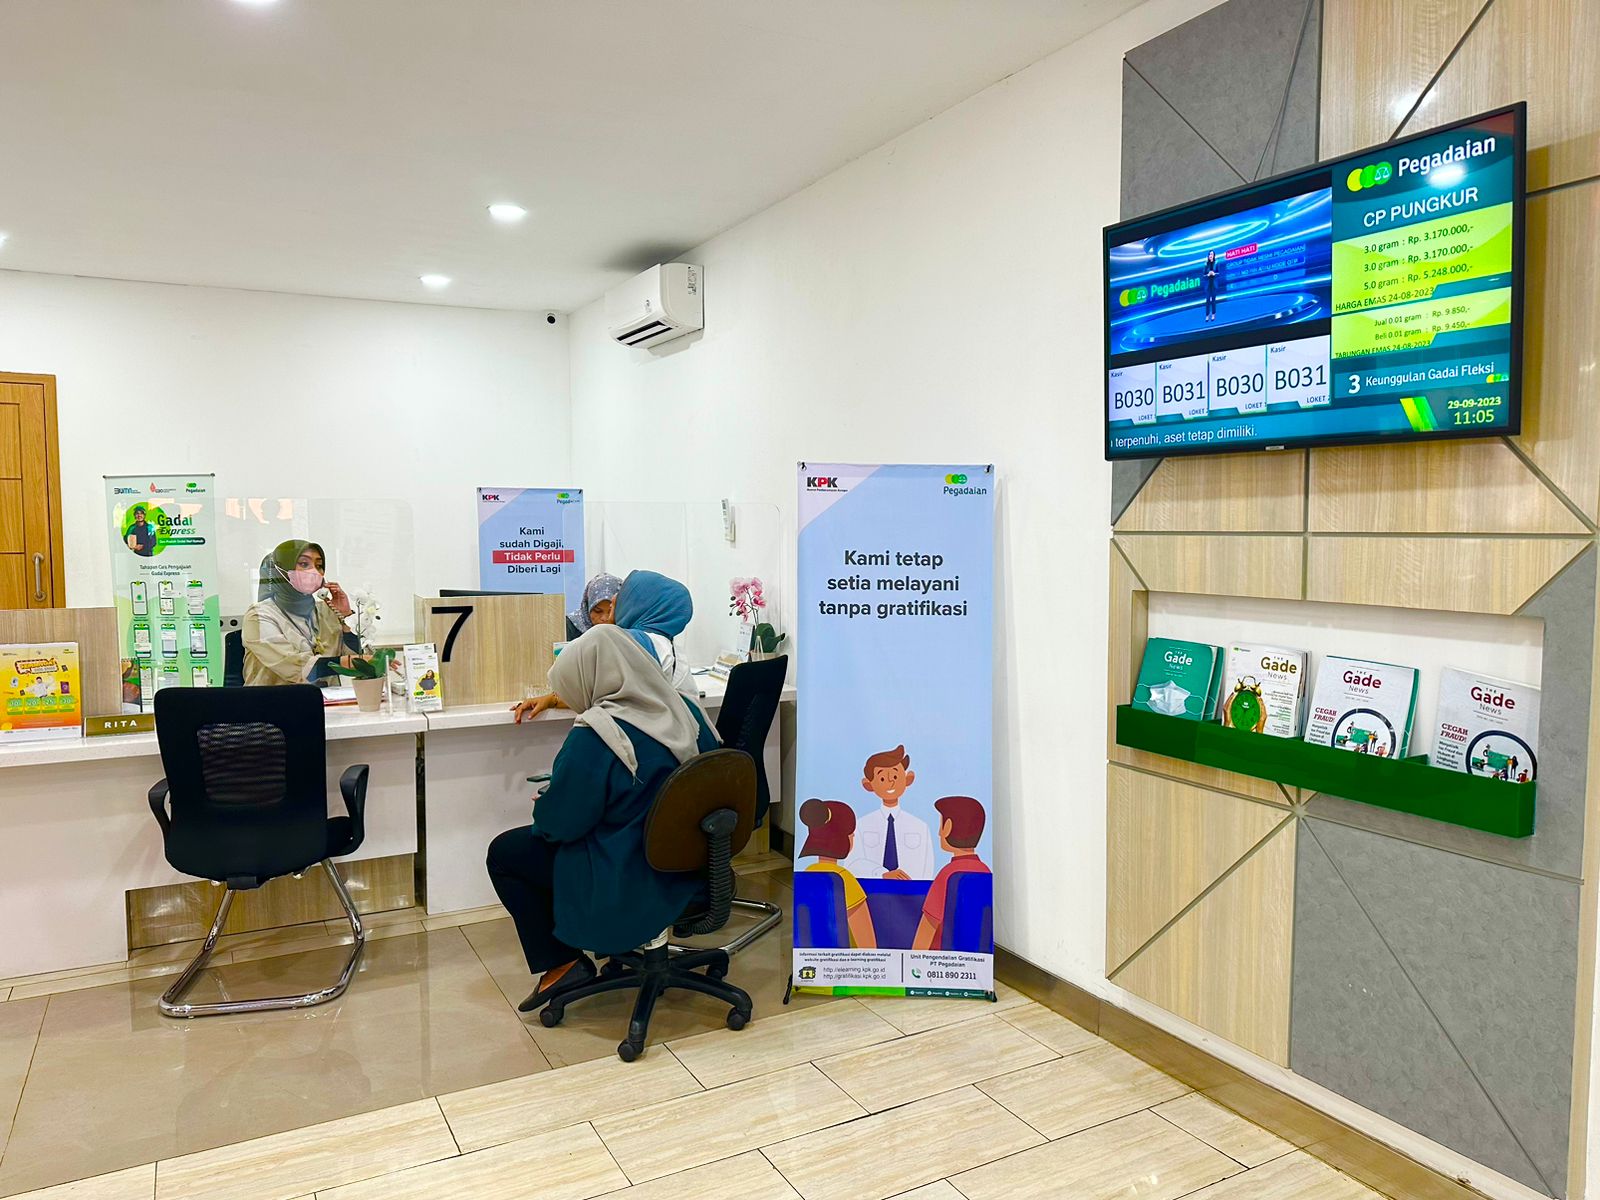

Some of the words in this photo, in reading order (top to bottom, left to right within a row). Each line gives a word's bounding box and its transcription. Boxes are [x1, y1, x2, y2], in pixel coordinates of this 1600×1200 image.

[1398, 137, 1496, 176] Pegadaian
[1363, 209, 1387, 228] CP
[1390, 186, 1479, 222] PUNGKUR
[1364, 243, 1377, 254] 3.0
[1378, 239, 1399, 253] gram
[1407, 233, 1422, 246] Rp.
[1423, 223, 1474, 241] 3.170.000,-
[1364, 263, 1377, 273] 3.0
[1378, 258, 1399, 272] gram
[1407, 253, 1422, 265] Rp.
[1423, 243, 1474, 261] 3.170.000,-
[1364, 281, 1377, 291] 5.0
[1378, 277, 1399, 290] gram
[1407, 272, 1422, 283] Rp.
[1423, 263, 1473, 279] 5.248.000,-
[1151, 276, 1201, 298] Pegadaian
[1335, 301, 1362, 311] HARGA
[1364, 296, 1387, 307] EMAS
[1388, 287, 1434, 302] 24-08-2023
[1374, 318, 1388, 327] Jual
[1388, 315, 1403, 324] 0.01
[1403, 313, 1422, 325] gram
[1375, 331, 1387, 341] Beli
[1388, 329, 1403, 339] 0.01
[1403, 327, 1422, 338] gram
[1270, 345, 1286, 353] Kasir
[1212, 354, 1227, 362] Kasir
[1275, 365, 1327, 390] B031
[1366, 370, 1426, 387] Keunggulan
[1428, 365, 1459, 380] Gadai
[1461, 361, 1495, 376] Fleksi
[1163, 380, 1205, 403] B031
[1216, 373, 1264, 397] B030
[1348, 374, 1361, 394] 3
[1115, 388, 1154, 409] B030
[1306, 395, 1325, 403] LOKET
[1447, 396, 1502, 409] 29-09-2023
[1454, 409, 1495, 425] 11:05
[1116, 433, 1161, 448] terpenuhi,
[1164, 432, 1185, 443] aset
[1188, 428, 1214, 442] tetap
[1217, 425, 1257, 439] dimiliki.
[807, 477, 838, 487] KPK
[943, 486, 987, 496] Pegadaian
[157, 514, 193, 526] Gadai
[161, 527, 196, 536] Express
[519, 527, 544, 535] Kami
[500, 540, 530, 548] sudah
[533, 540, 564, 549] Digaji,
[504, 552, 532, 560] Tidak
[535, 552, 560, 560] Perlu
[844, 550, 890, 566] Kami
[896, 552, 943, 569] tetap
[508, 565, 537, 574] Diberi
[540, 565, 561, 574] Lagi
[827, 575, 870, 590] setia
[877, 576, 959, 594] melayani
[819, 601, 871, 618] tanpa
[877, 600, 967, 619] gratifikasi
[432, 606, 473, 662] 7
[1165, 651, 1192, 665] Gade
[1261, 656, 1297, 674] Gade
[1268, 672, 1287, 680] News
[1343, 671, 1381, 688] Gade
[1349, 685, 1369, 694] News
[1471, 686, 1515, 709] Gade
[1315, 707, 1337, 716] CEGAH
[1479, 703, 1502, 715] News
[104, 720, 137, 729] RITA
[1441, 723, 1468, 735] CEGAH
[961, 972, 976, 980] 2311
